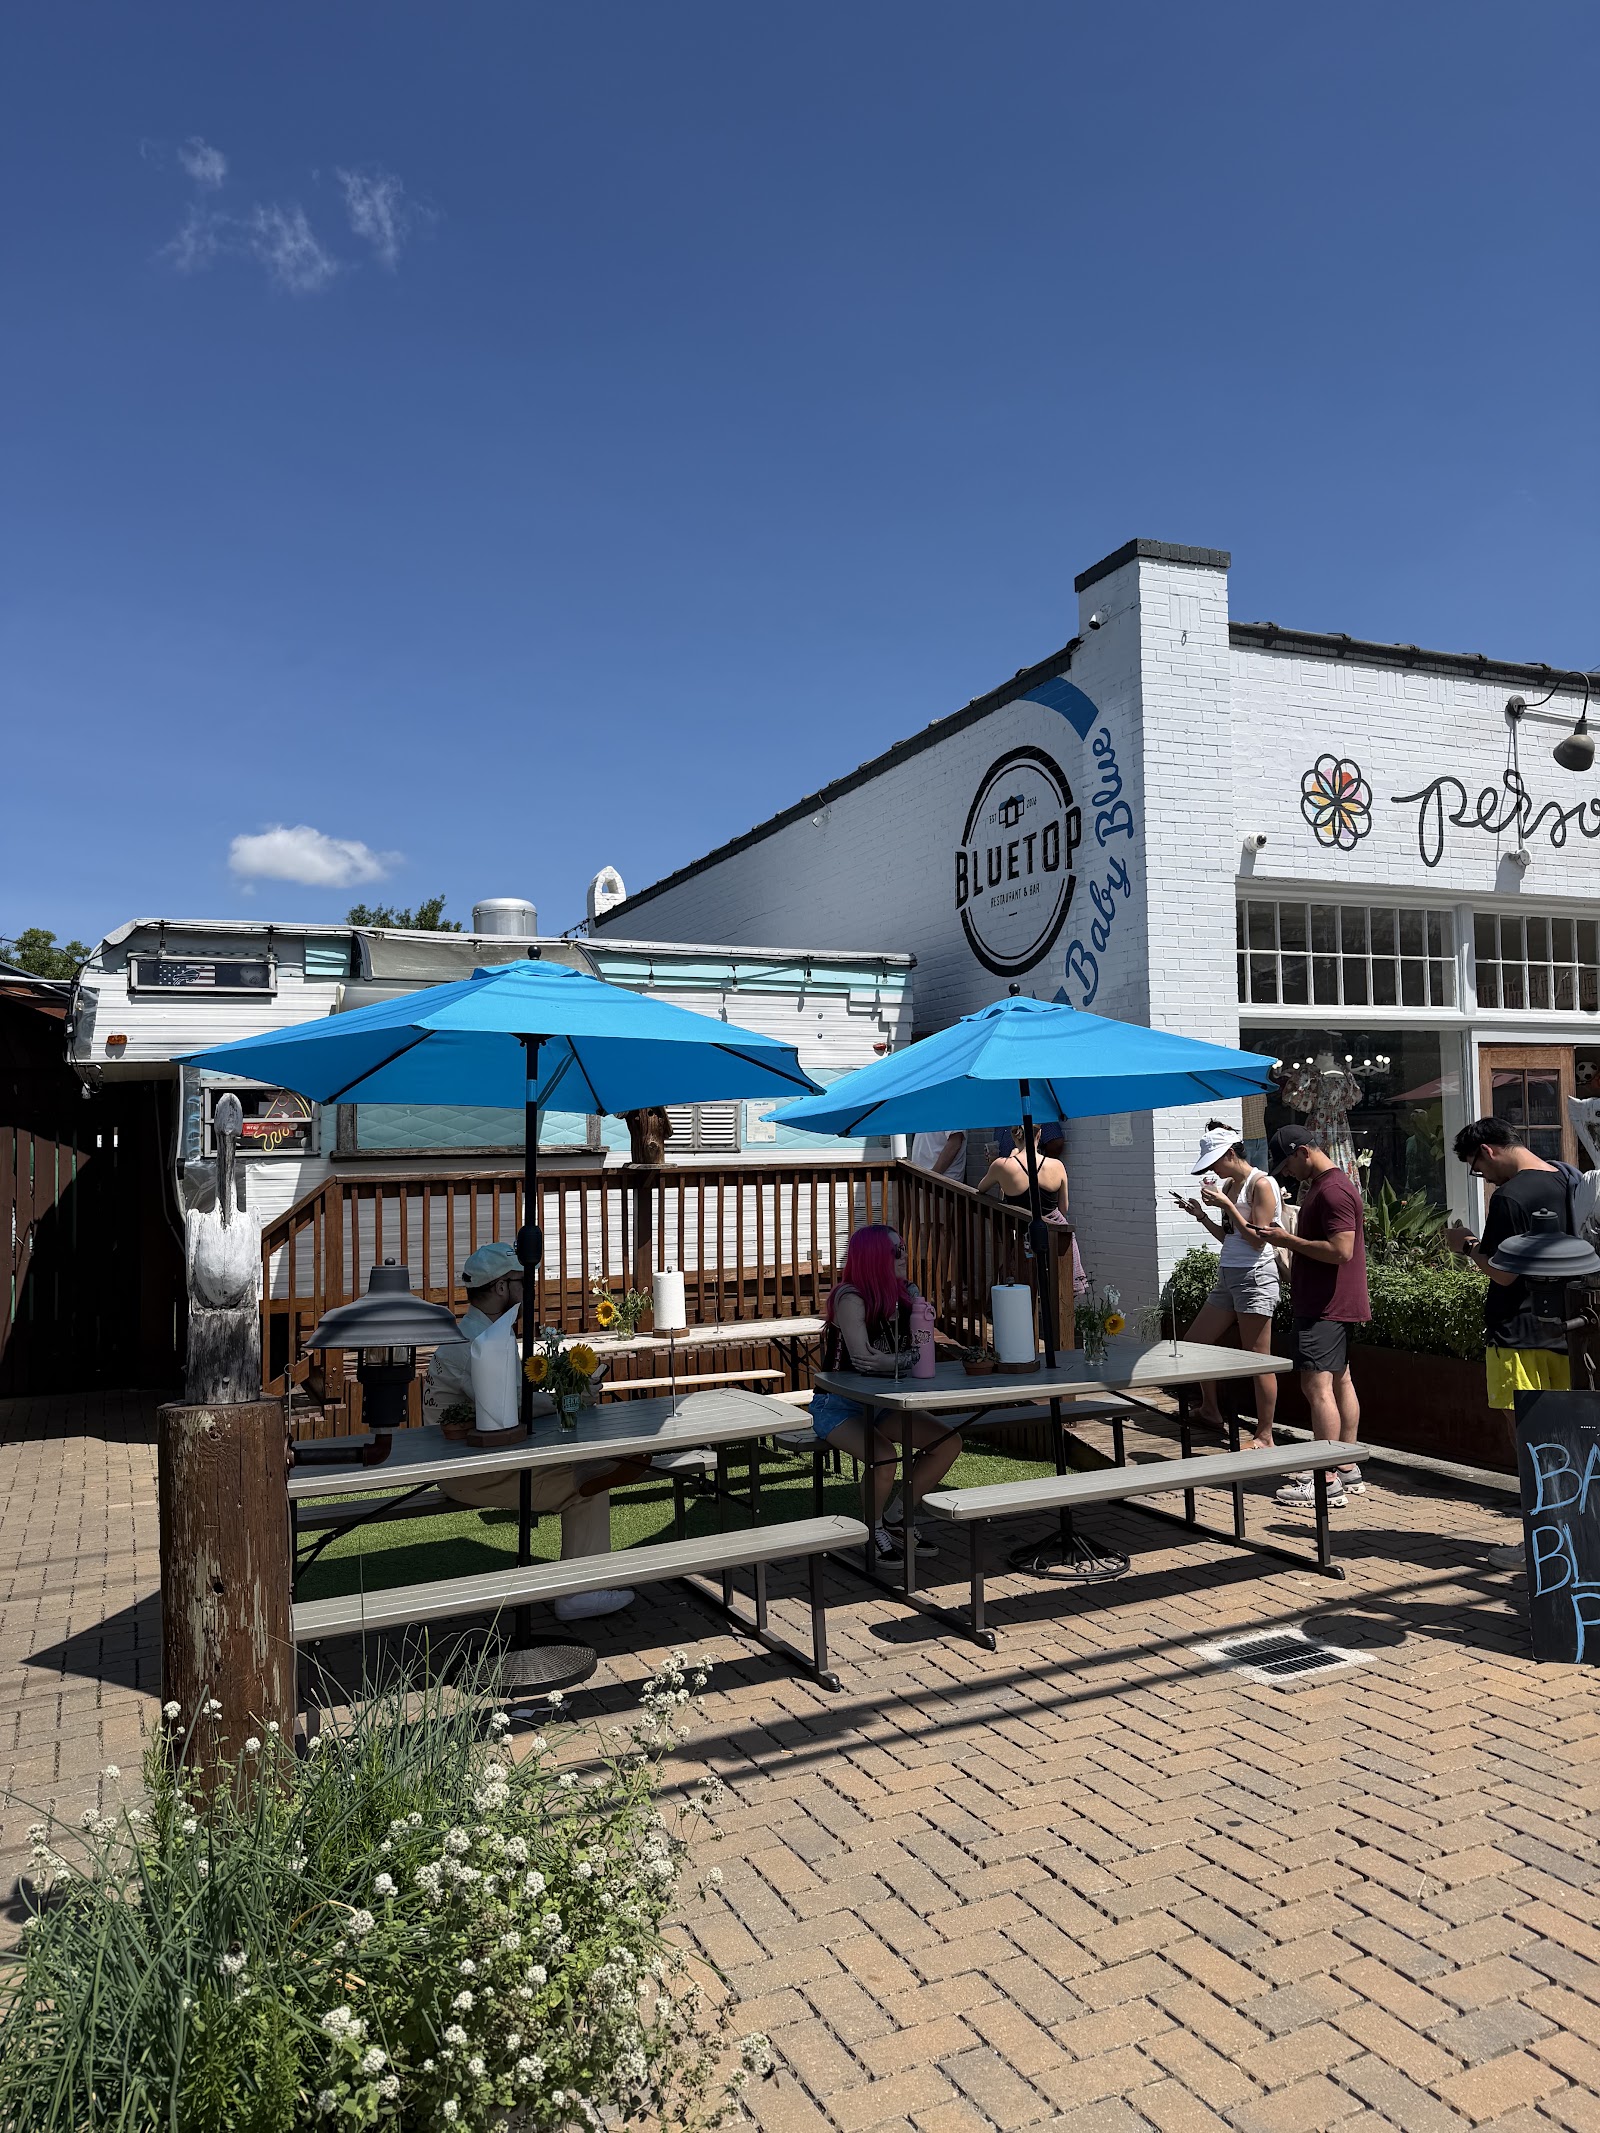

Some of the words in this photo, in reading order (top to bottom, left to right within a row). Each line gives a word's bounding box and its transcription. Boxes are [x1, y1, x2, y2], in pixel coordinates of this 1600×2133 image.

[989, 813, 997, 825] EST
[1092, 727, 1134, 848] Blue
[955, 806, 1081, 910] BLUETOP
[990, 888, 1021, 908] RESTAURANT
[1023, 887, 1028, 897] &
[1029, 883, 1040, 896] BAR
[1065, 856, 1131, 1007] Baby
